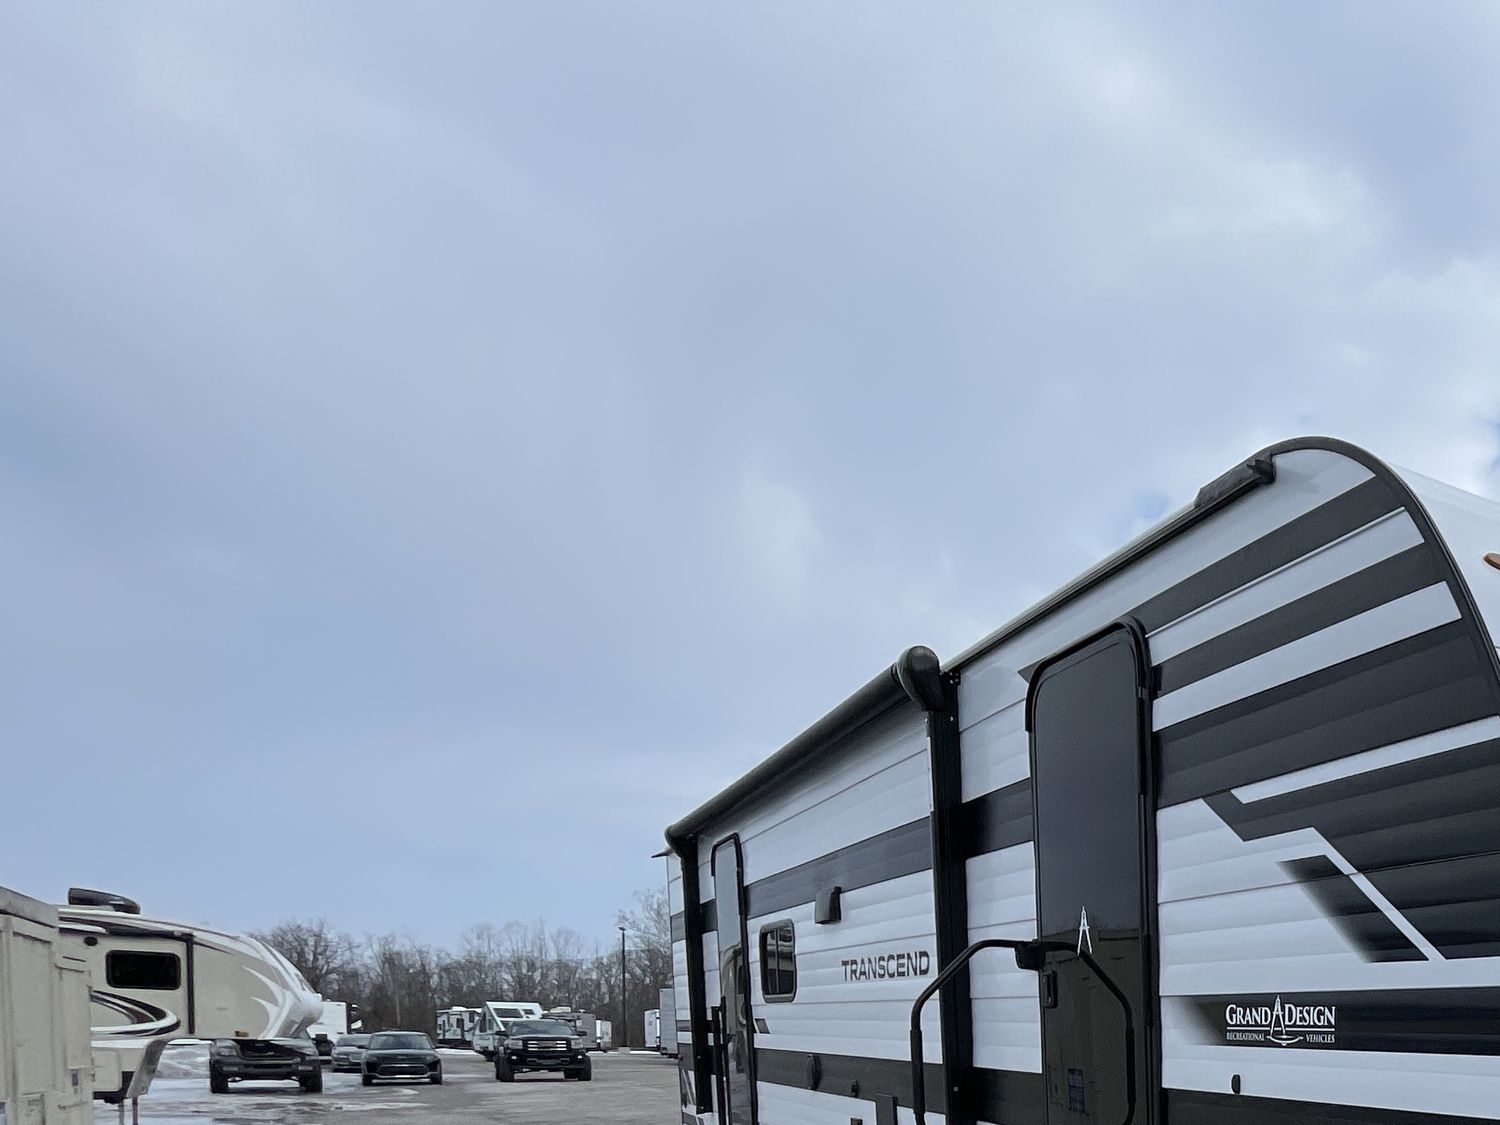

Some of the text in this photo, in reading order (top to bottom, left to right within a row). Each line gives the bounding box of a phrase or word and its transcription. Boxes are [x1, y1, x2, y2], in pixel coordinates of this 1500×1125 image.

[841, 950, 930, 982] TRANSCEND
[1225, 1003, 1336, 1026] GRAND DESIGN
[1226, 1032, 1336, 1043] RECREATIONAL VEHICLES
